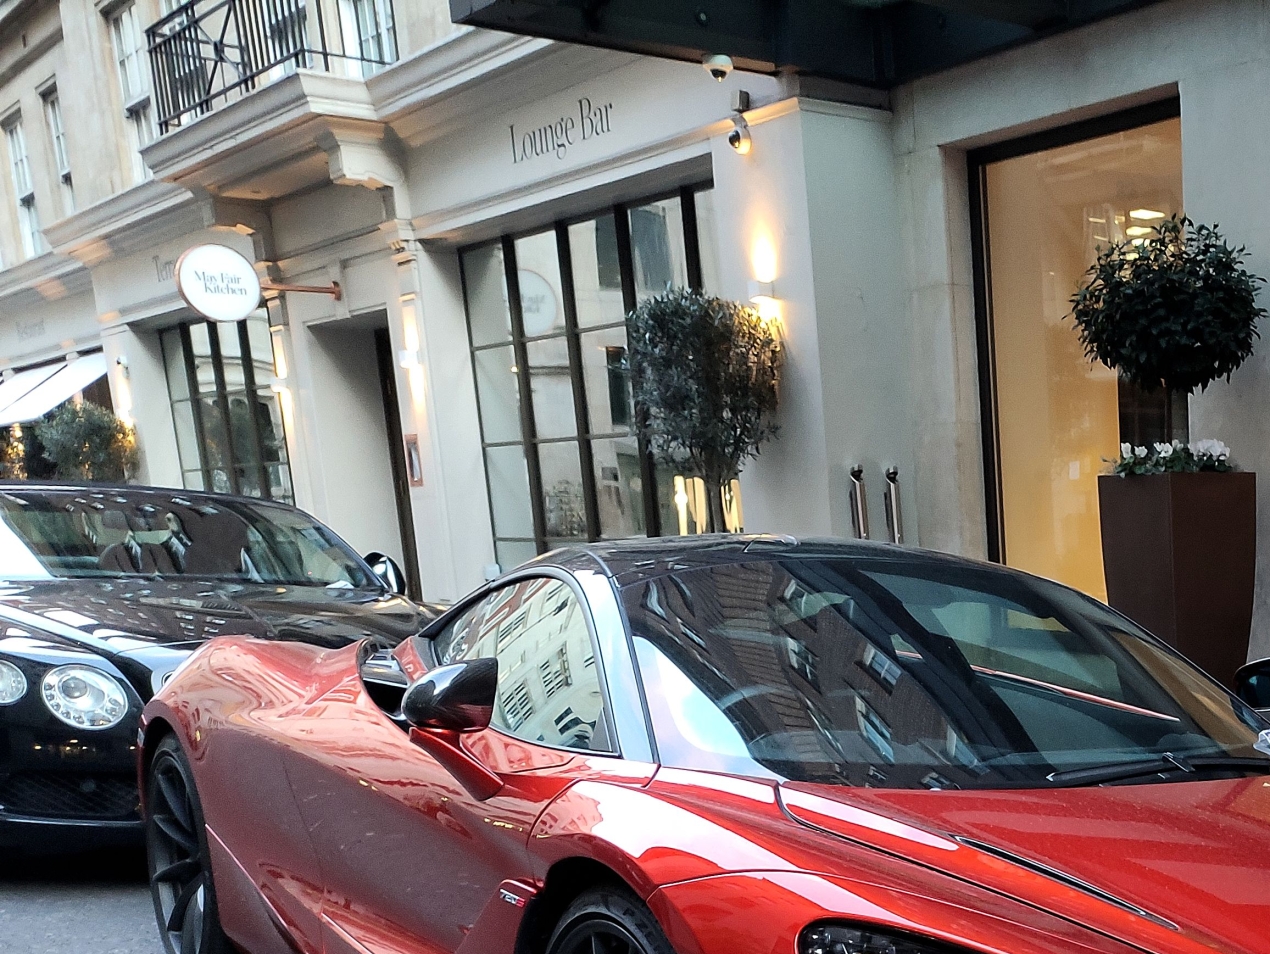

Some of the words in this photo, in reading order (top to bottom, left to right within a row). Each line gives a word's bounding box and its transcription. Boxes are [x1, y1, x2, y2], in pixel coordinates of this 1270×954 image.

[509, 117, 575, 164] Lounge
[578, 97, 613, 140] Bar
[194, 270, 219, 285] May
[220, 272, 242, 285] Fair
[204, 282, 248, 296] Kitchen
